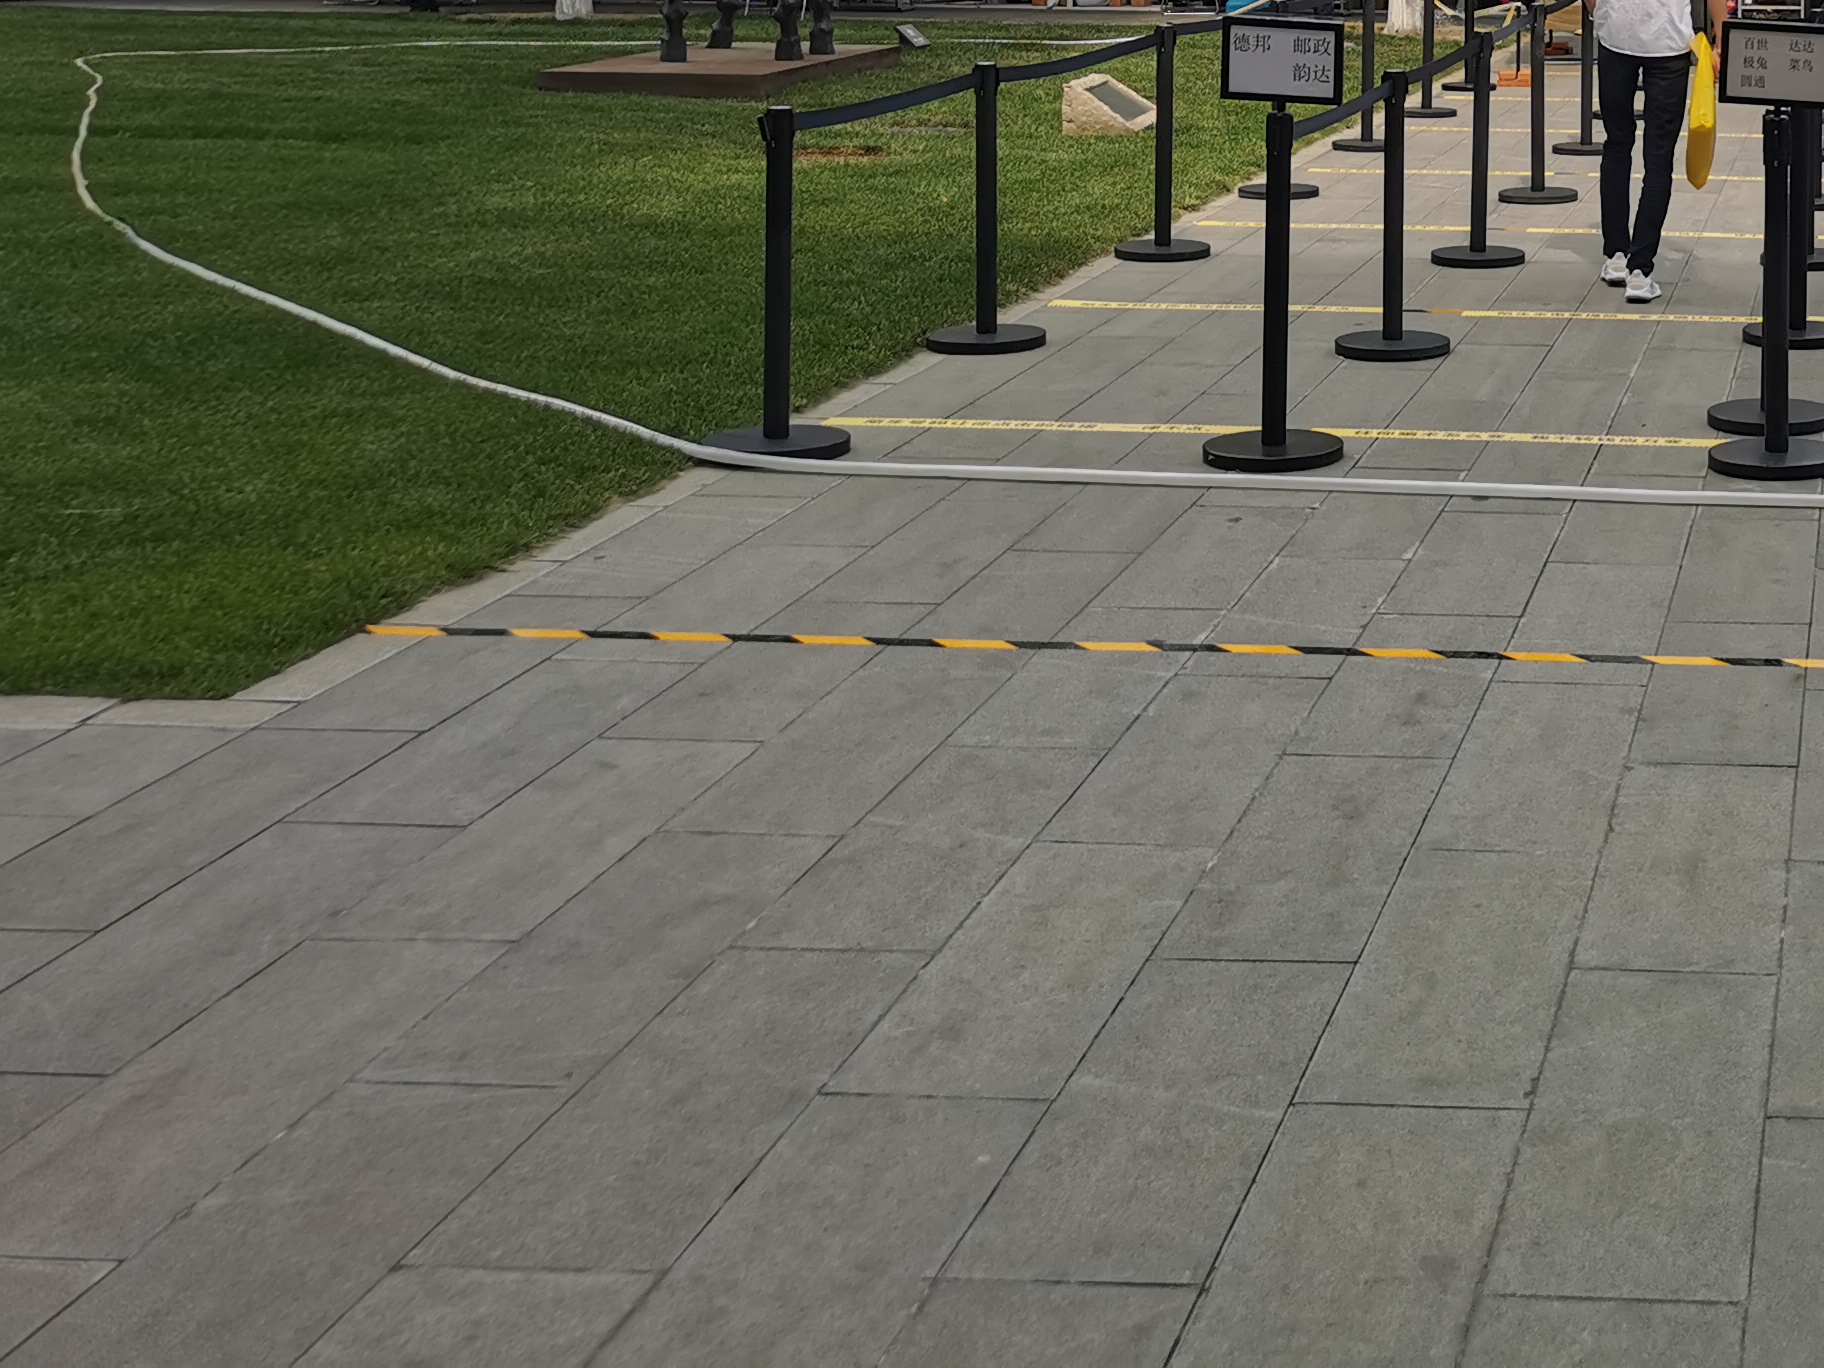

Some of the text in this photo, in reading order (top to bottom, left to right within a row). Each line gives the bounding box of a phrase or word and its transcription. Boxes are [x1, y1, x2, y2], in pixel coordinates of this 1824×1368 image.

[1233, 33, 1331, 56] 德邦 邮政
[1744, 37, 1815, 53] 百世 达达
[1743, 54, 1813, 72] 极兔 菜鸟
[1292, 63, 1331, 83] 韵达
[1740, 74, 1766, 88] 圆通
